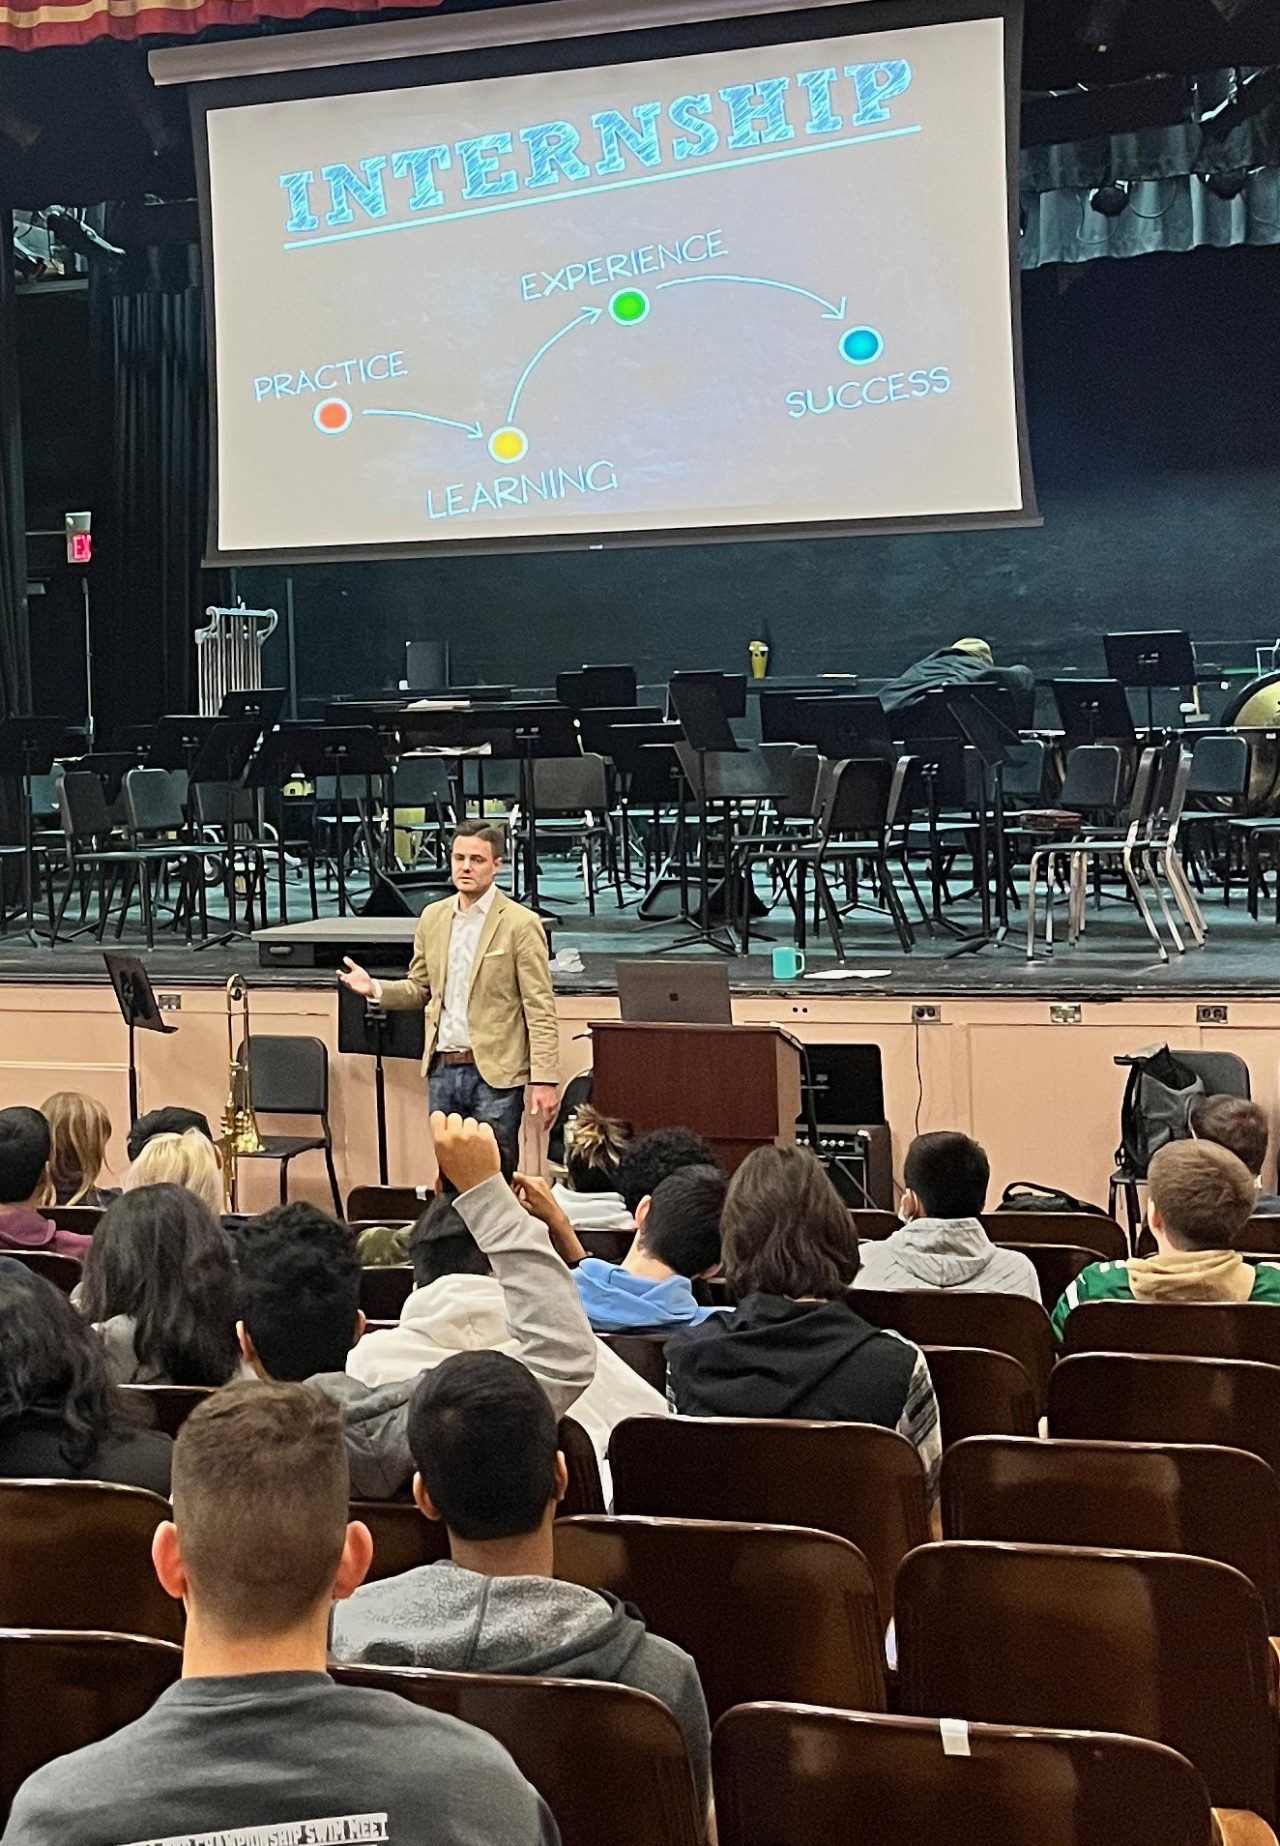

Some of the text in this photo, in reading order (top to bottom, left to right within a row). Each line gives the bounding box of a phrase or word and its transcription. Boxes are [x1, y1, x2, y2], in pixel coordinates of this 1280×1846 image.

[278, 58, 913, 233] INTERNSHIP
[521, 229, 728, 301] EXPERIENCE
[253, 349, 408, 402] PRACTICE
[784, 366, 951, 419] SUCCESS
[426, 460, 618, 520] LEARNING
[348, 1819, 387, 1840] MEET
